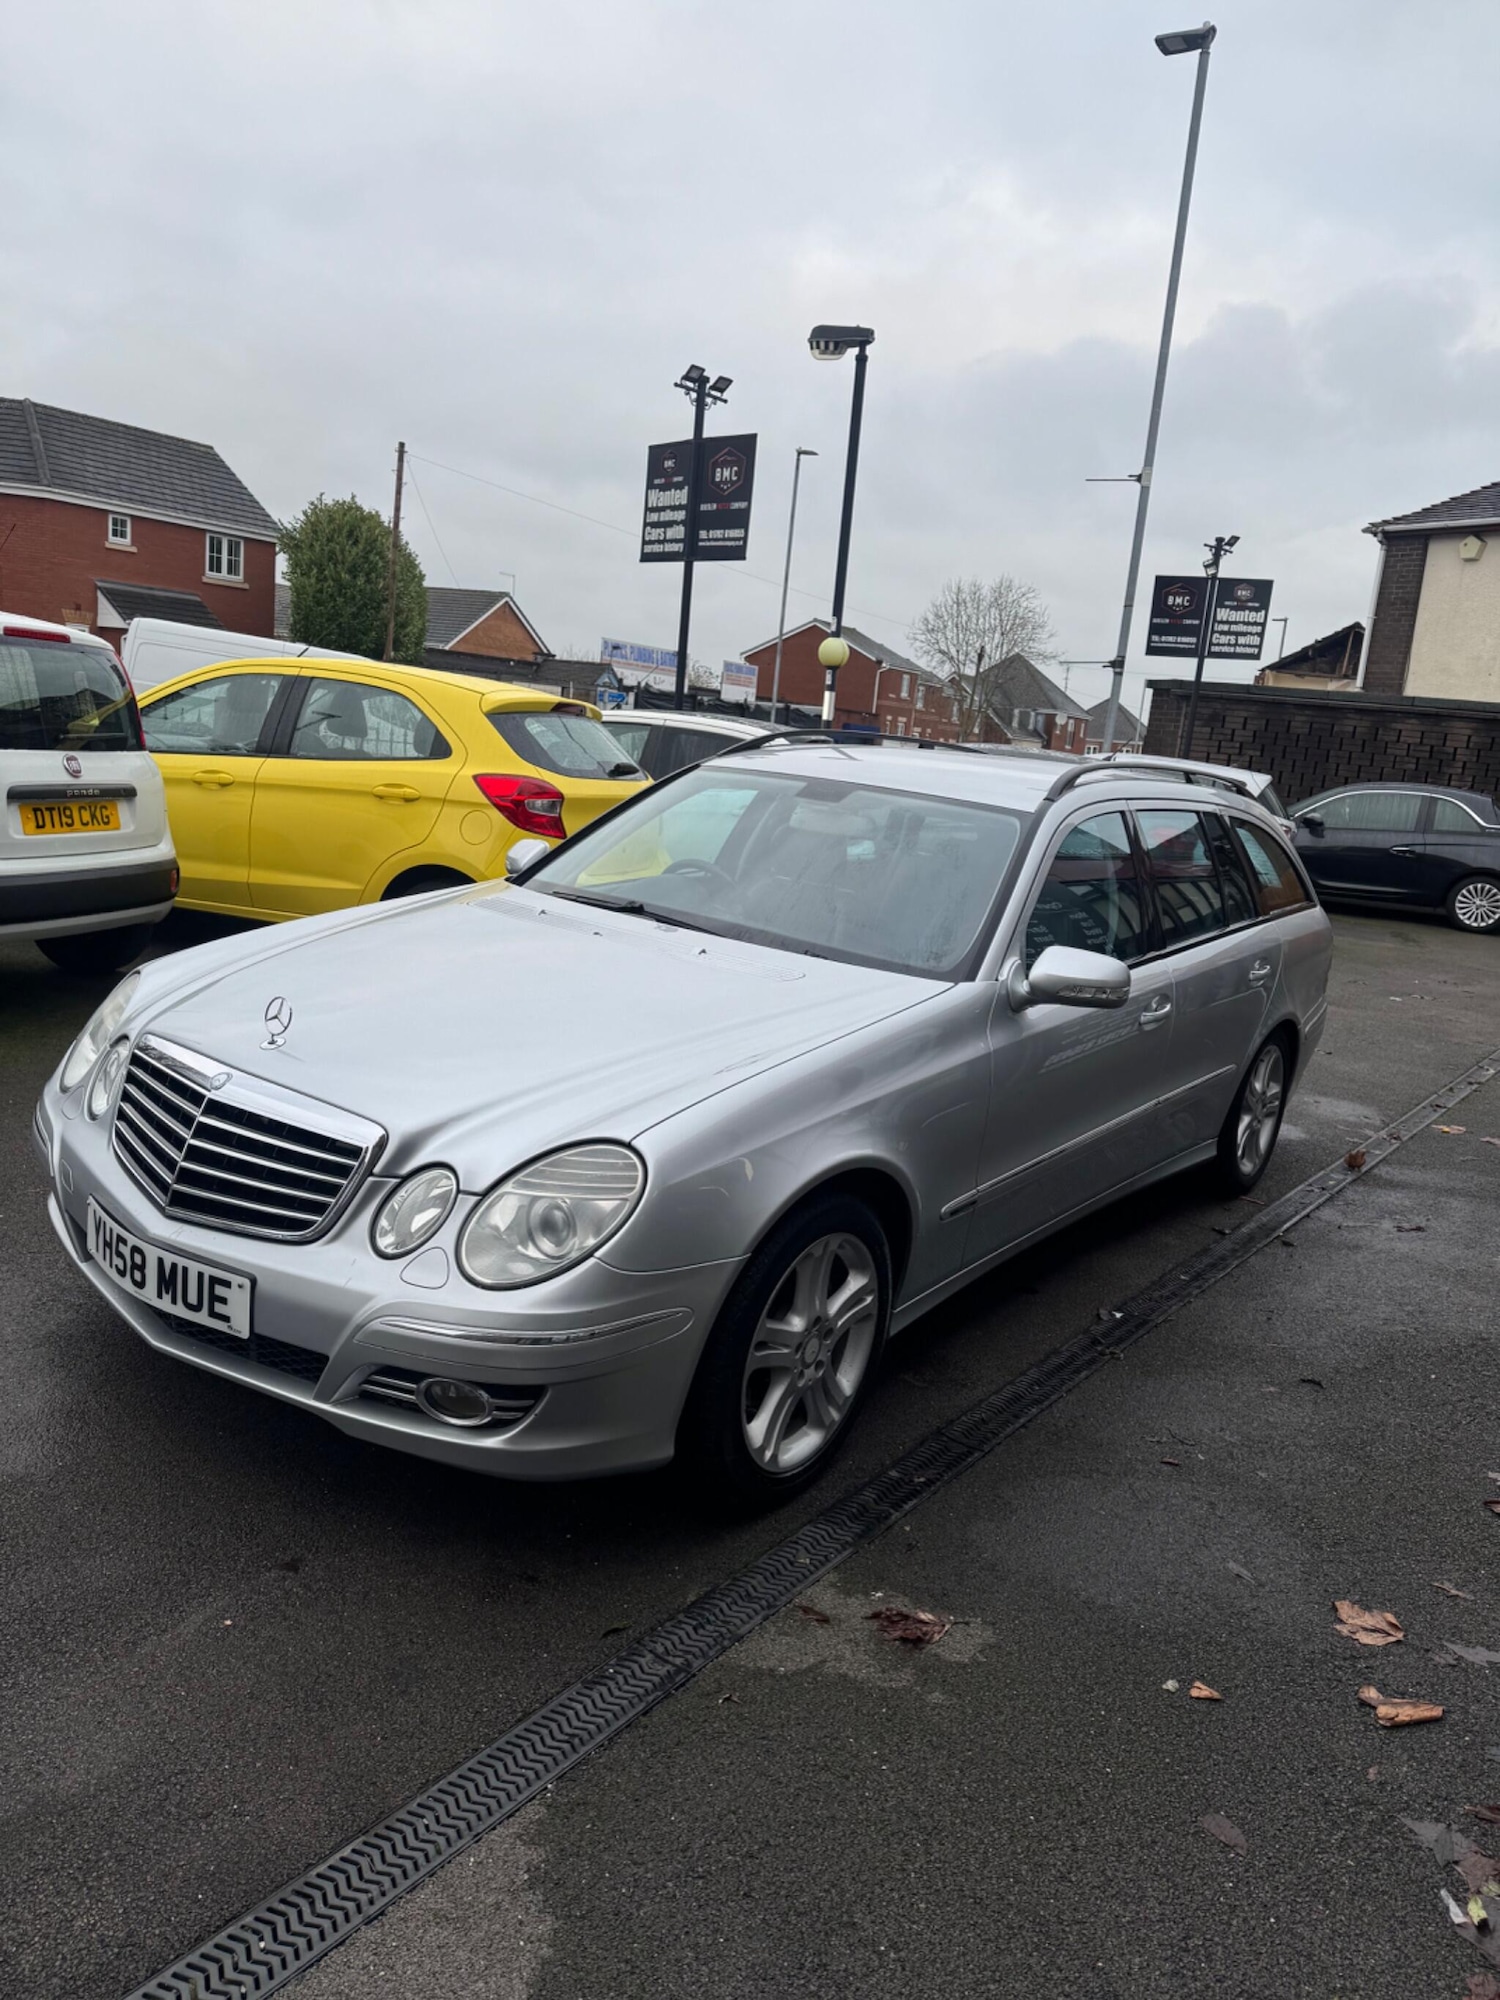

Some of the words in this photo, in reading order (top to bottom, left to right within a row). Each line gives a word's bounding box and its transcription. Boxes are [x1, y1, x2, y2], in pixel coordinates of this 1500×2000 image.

[714, 466, 739, 482] BMC
[647, 485, 689, 508] Wanted
[646, 511, 660, 523] Low
[660, 509, 686, 522] mileage
[644, 526, 665, 541] Cars
[665, 524, 685, 540] with
[643, 543, 663, 553] service
[664, 542, 685, 553] history
[1167, 595, 1191, 606] BMC
[1216, 607, 1266, 623] Wanted
[1214, 622, 1230, 632] Low
[1230, 623, 1262, 634] mileage
[1212, 633, 1236, 645] Cars
[1237, 634, 1261, 646] with
[1210, 645, 1235, 653] service
[1235, 646, 1259, 655] history
[66, 788, 100, 797] panda
[32, 805, 75, 829] DT19
[78, 804, 111, 826] CKG
[93, 1208, 147, 1291] YH58
[157, 1255, 232, 1324] MUE
